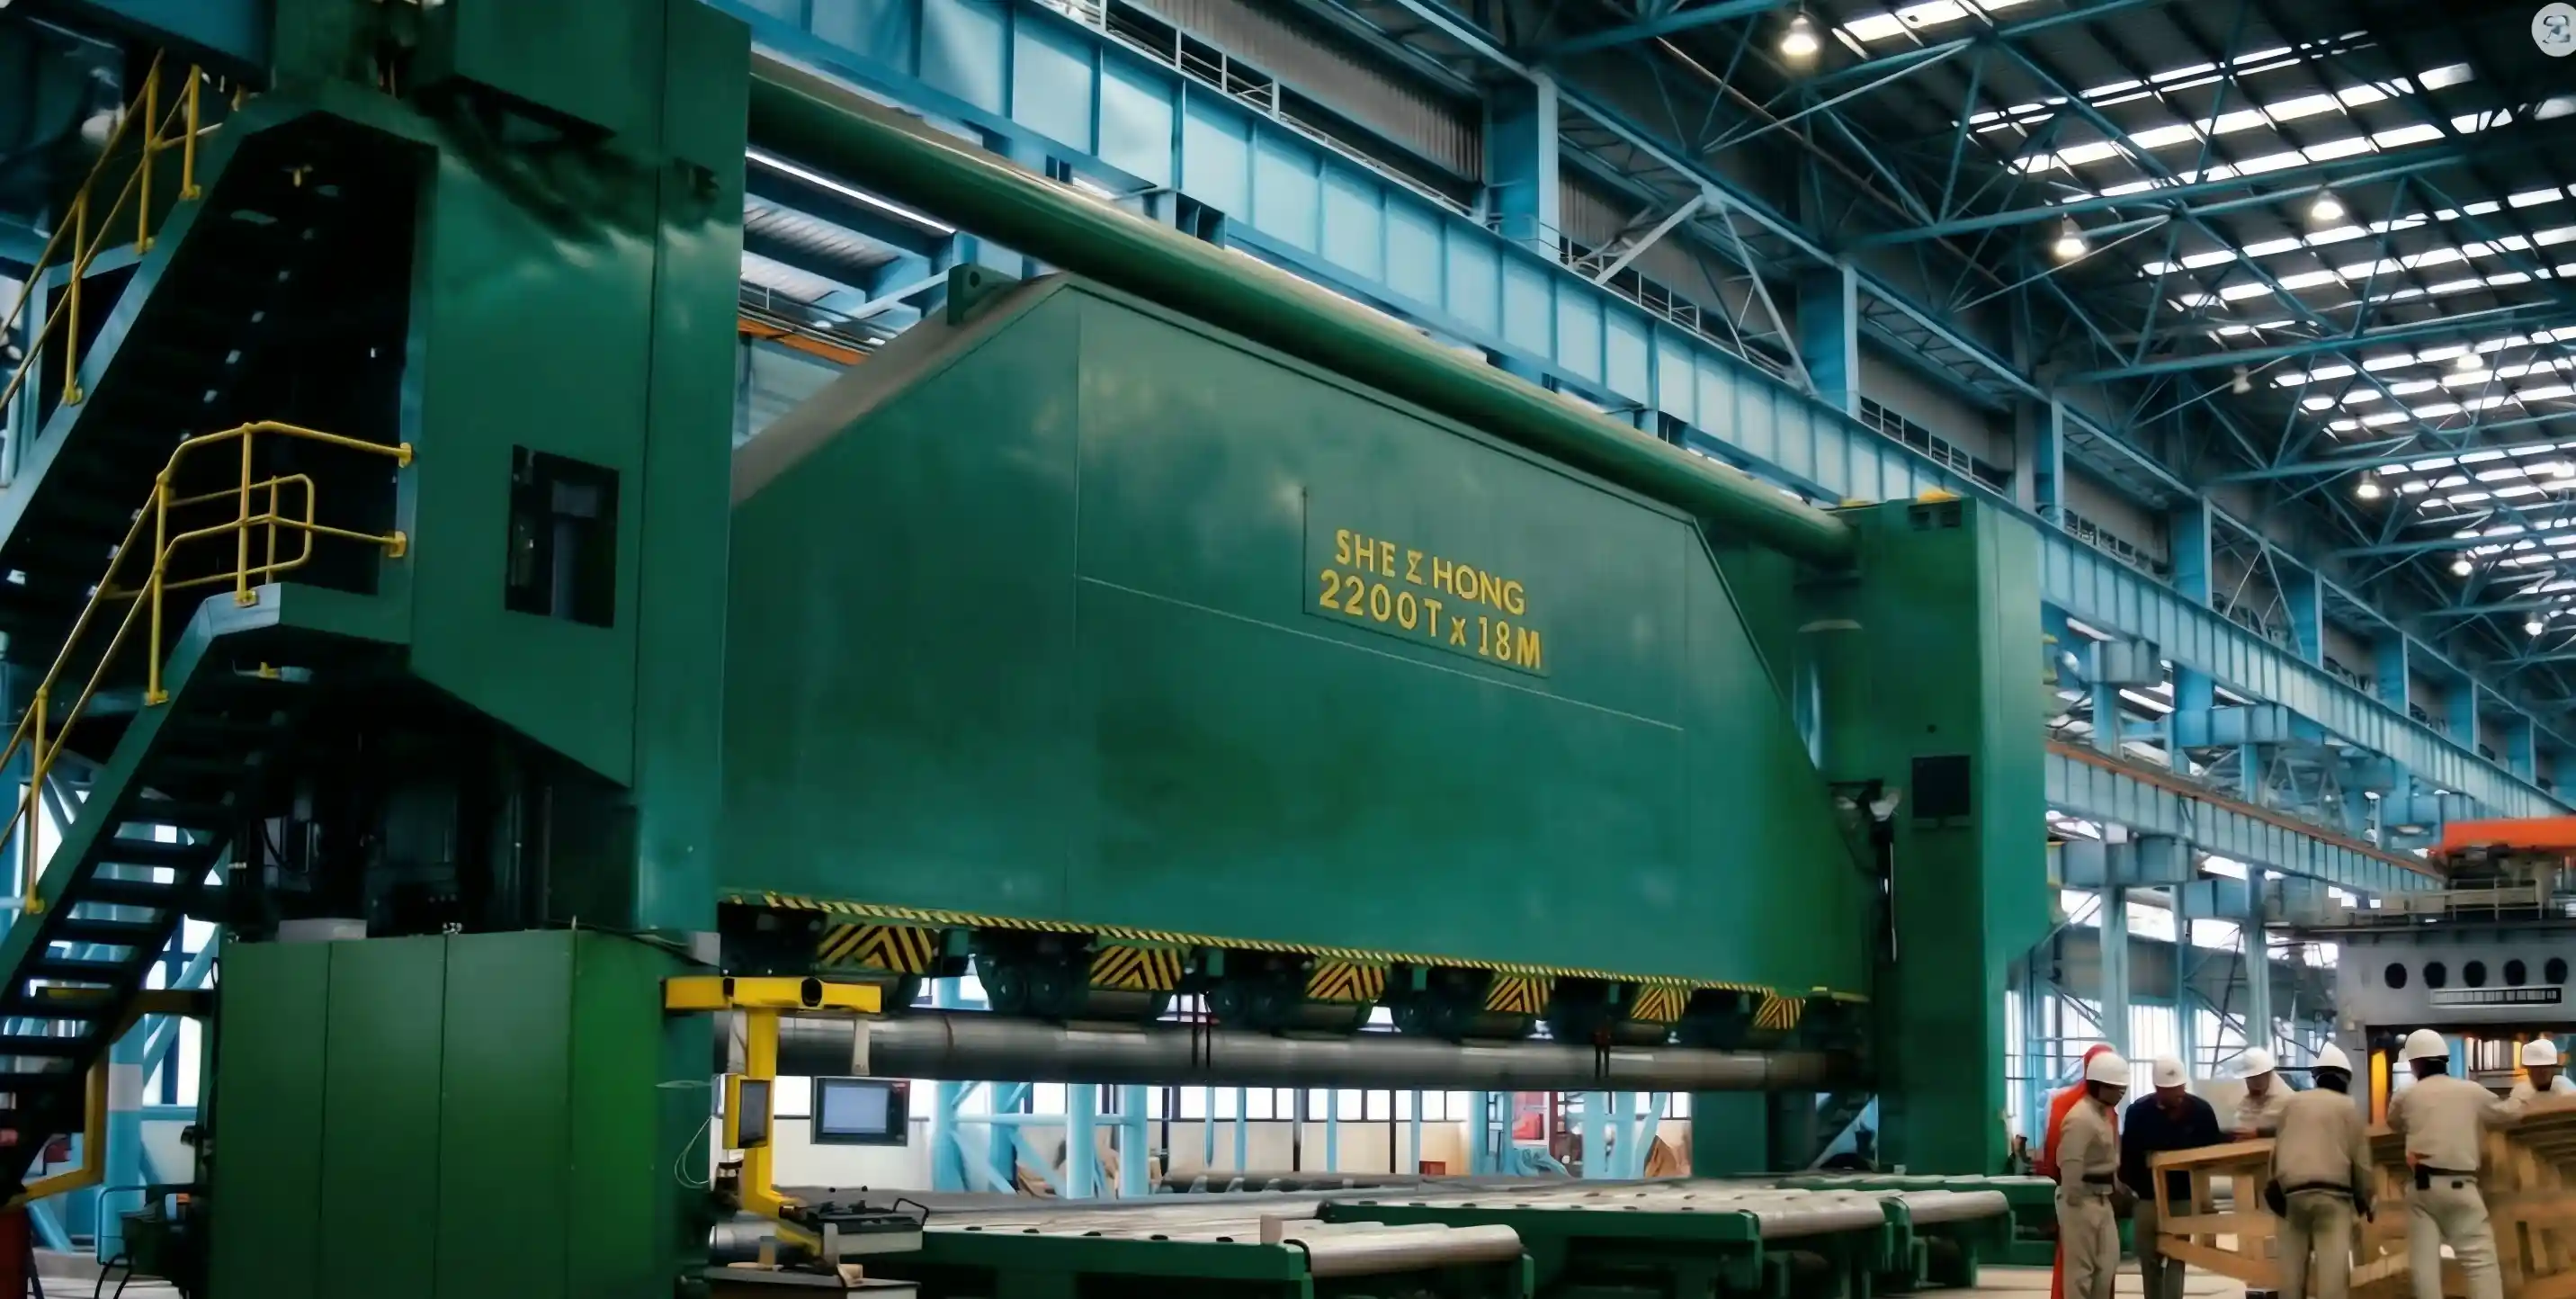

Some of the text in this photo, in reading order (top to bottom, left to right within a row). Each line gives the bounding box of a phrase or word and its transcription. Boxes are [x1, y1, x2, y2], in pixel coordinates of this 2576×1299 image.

[1335, 528, 1395, 578] SHE
[1433, 556, 1525, 615] HONG
[1319, 569, 1443, 638] 2200T
[1478, 615, 1541, 669] 18M
